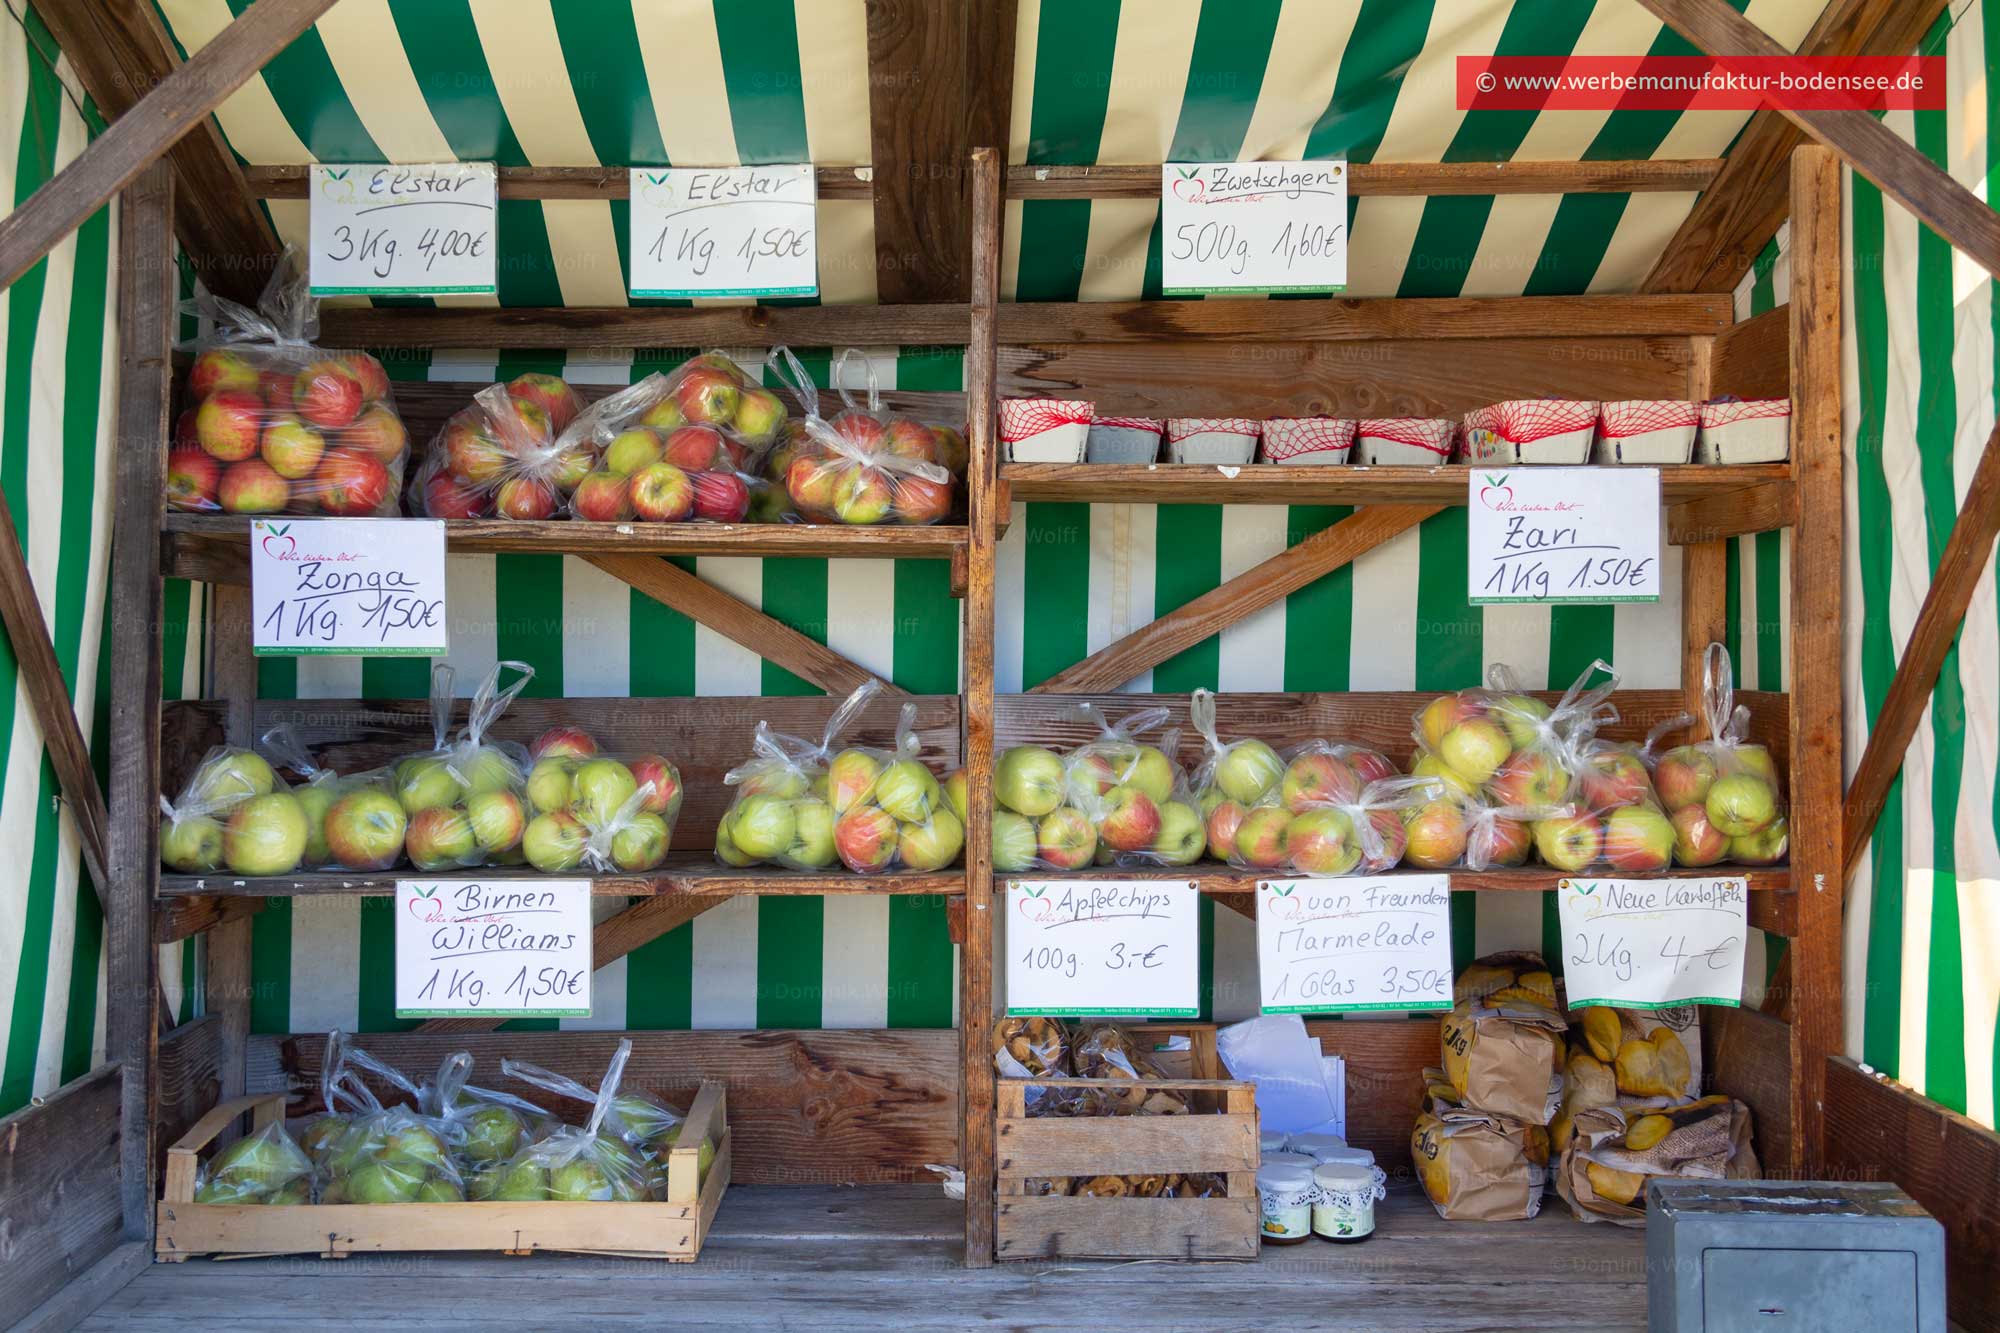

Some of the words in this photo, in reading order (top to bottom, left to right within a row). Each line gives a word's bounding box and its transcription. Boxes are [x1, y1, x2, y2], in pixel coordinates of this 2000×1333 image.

[688, 172, 797, 200] Elstar
[1209, 166, 1340, 199] Zwetschgen
[417, 228, 488, 271] 4,00€
[736, 227, 811, 272] 1,50€
[1271, 221, 1343, 270] 1,60€
[1502, 515, 1583, 550] Zari
[296, 562, 420, 611] Zonga
[362, 594, 444, 642] 1,50€
[454, 884, 555, 912] Birnen
[1056, 887, 1171, 921] Apfelchips
[1362, 885, 1449, 909] Freunden
[1606, 883, 1658, 910] Neue
[431, 923, 576, 950] Williams
[1277, 921, 1436, 953] Marmelade
[504, 965, 585, 1007] 1,50€
[1300, 968, 1356, 999] Glas
[1380, 966, 1451, 999] 3,50€
